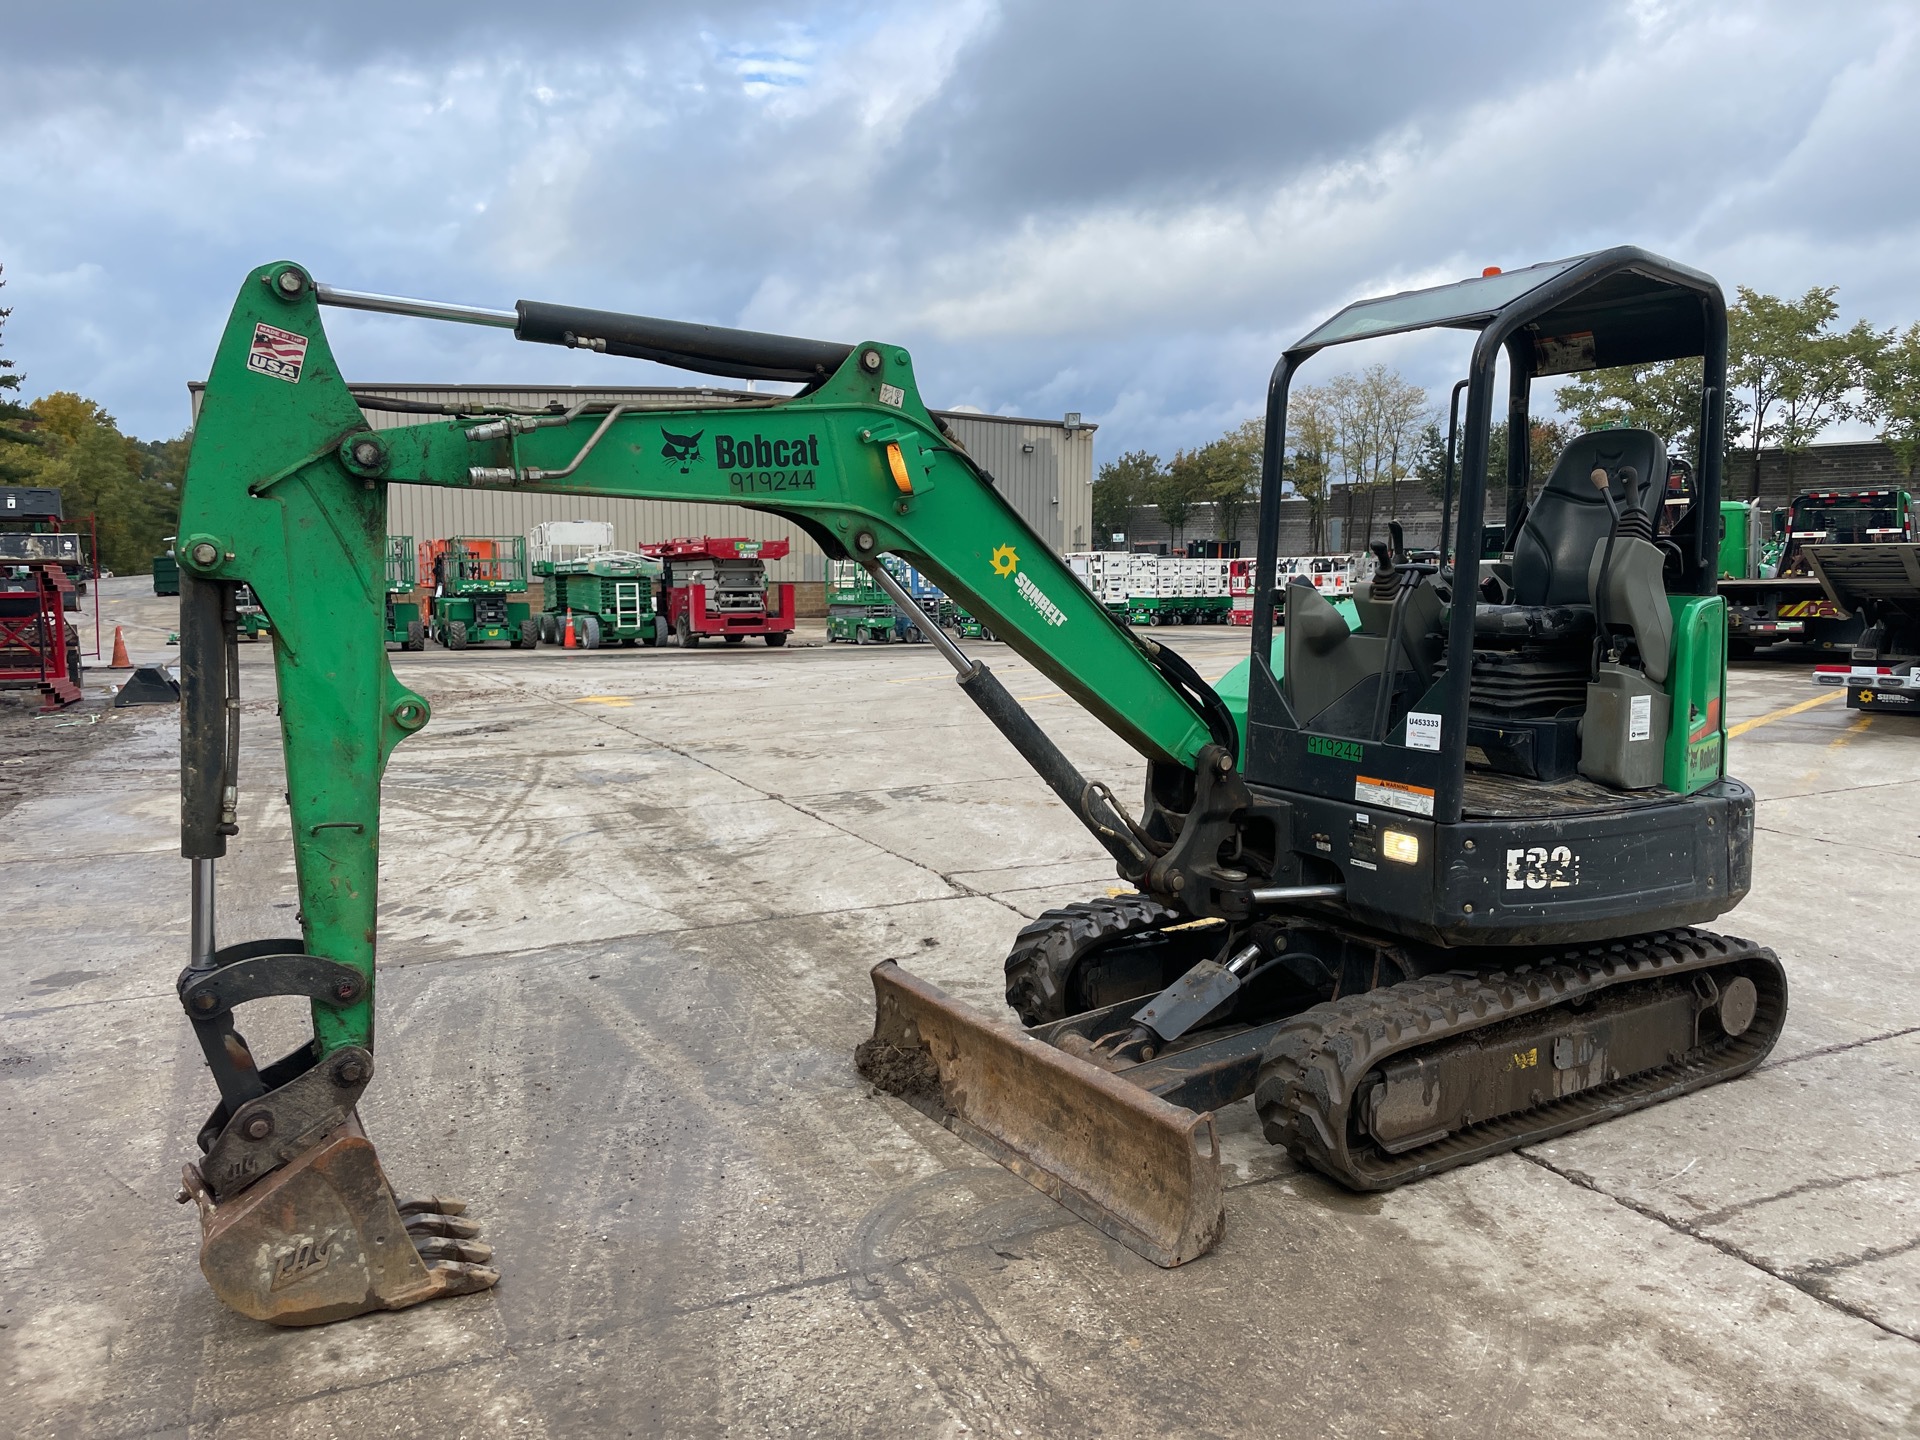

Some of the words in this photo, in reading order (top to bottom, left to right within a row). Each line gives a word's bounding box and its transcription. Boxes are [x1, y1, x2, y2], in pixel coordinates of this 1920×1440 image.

[260, 326, 280, 337] MADE
[252, 354, 295, 377] USA
[715, 434, 820, 469] Bobcat
[730, 470, 815, 492] 919244
[1014, 571, 1068, 627] SUNBELT
[1017, 588, 1053, 626] RENTALS
[1409, 718, 1439, 728] U453333
[1309, 736, 1362, 761] 919244
[1385, 781, 1409, 791] WARNING
